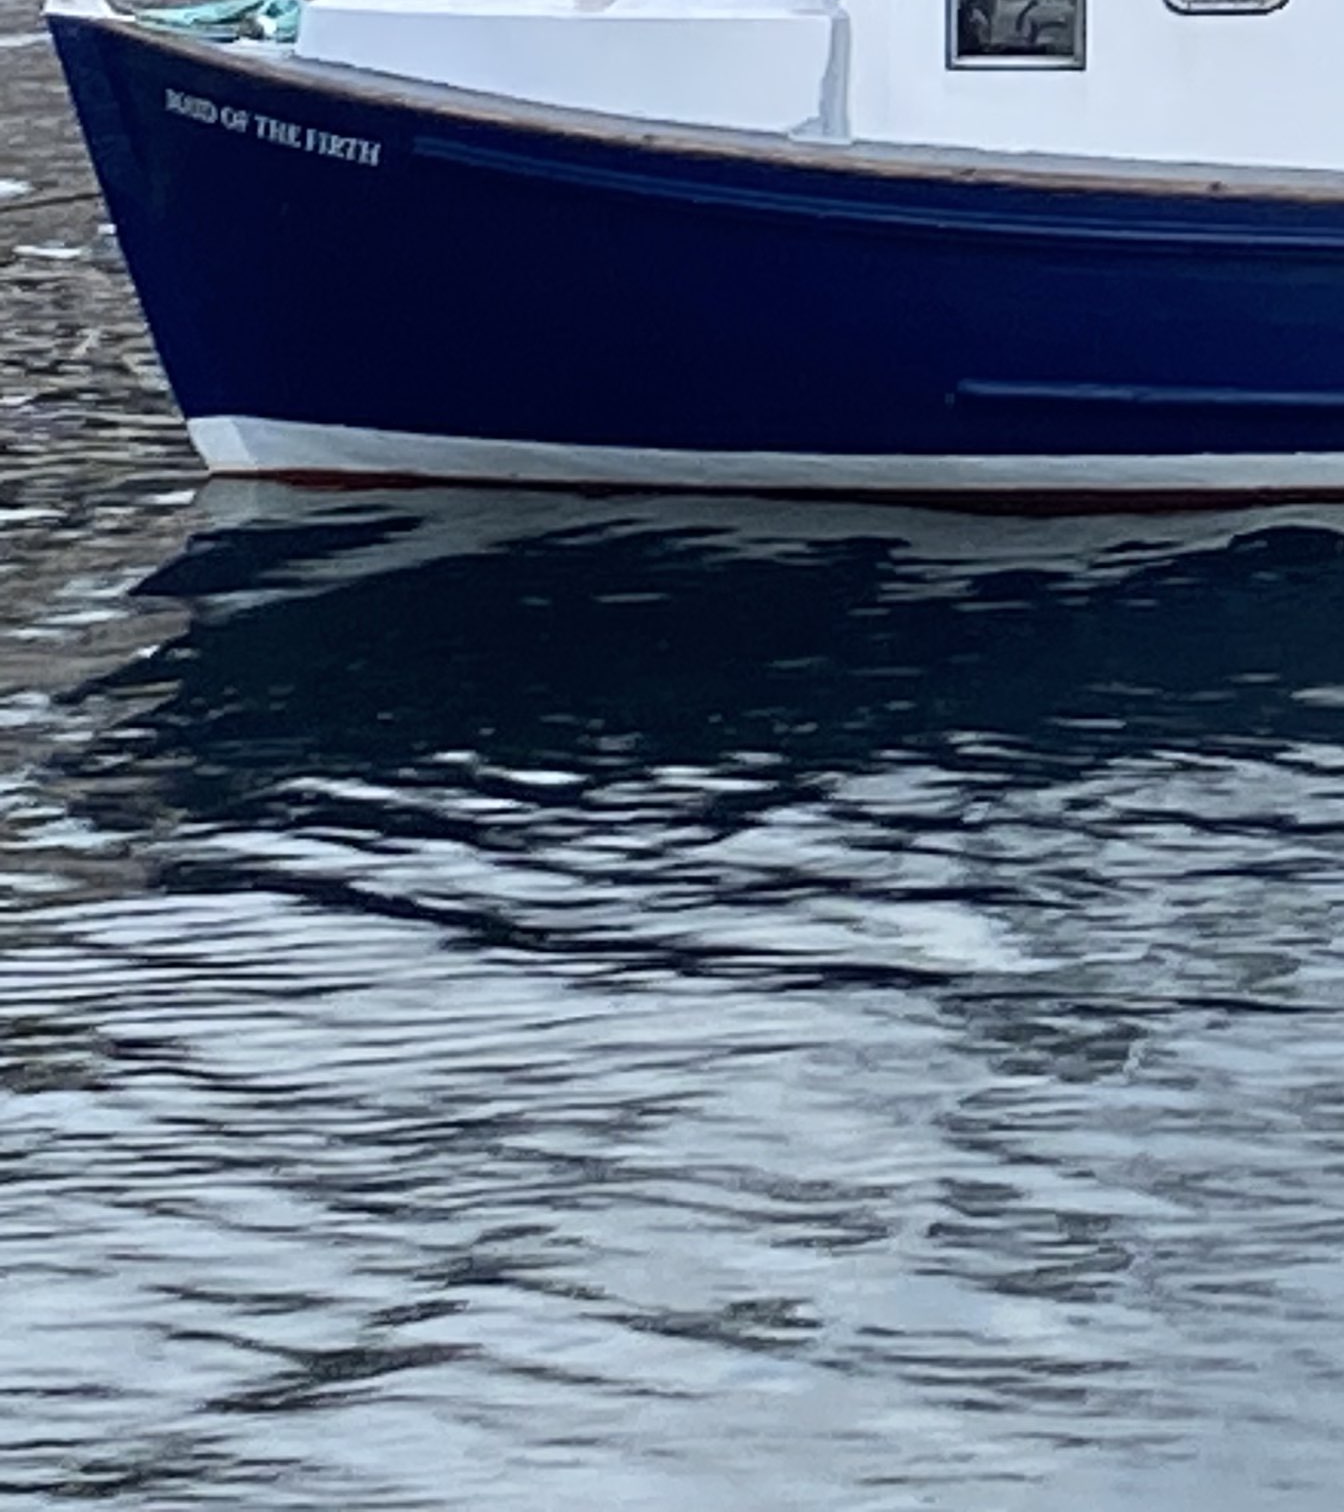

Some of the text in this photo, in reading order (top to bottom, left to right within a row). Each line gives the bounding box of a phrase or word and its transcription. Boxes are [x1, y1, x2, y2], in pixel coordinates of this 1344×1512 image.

[220, 106, 249, 133] OF
[254, 114, 302, 149] THE
[304, 128, 382, 167] FIRTH
